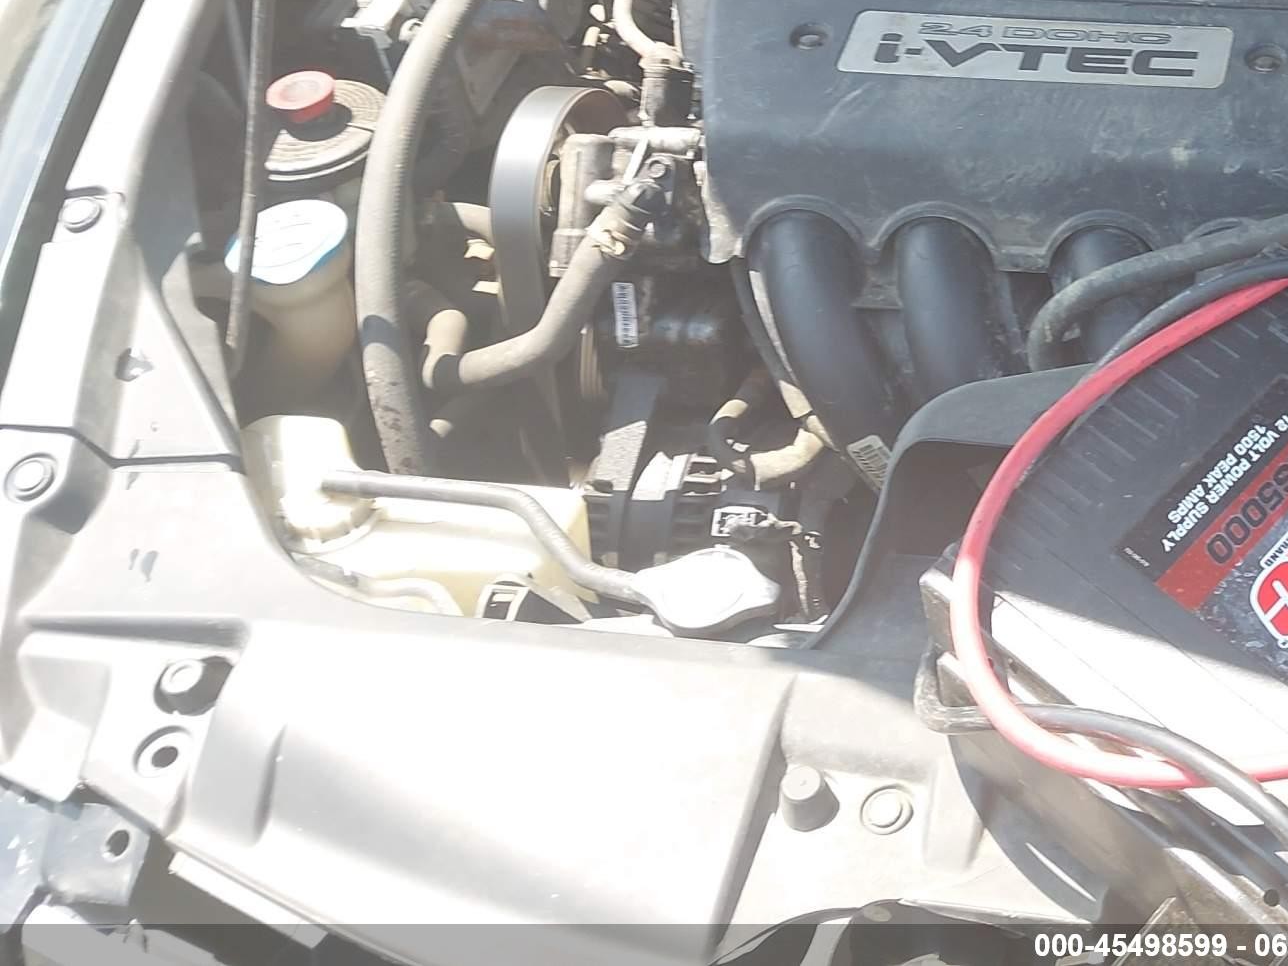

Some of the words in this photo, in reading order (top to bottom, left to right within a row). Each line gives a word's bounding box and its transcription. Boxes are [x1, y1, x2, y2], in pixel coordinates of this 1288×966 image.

[1001, 25, 1172, 45] DOHC
[874, 32, 1198, 78] i-VTEC
[1232, 422, 1267, 456] 1500
[1245, 429, 1280, 462] VOLT
[1200, 451, 1238, 487] PEAK
[1202, 457, 1252, 505] POWER
[1165, 482, 1205, 524] AMPS
[1160, 499, 1211, 553] SUPPLY
